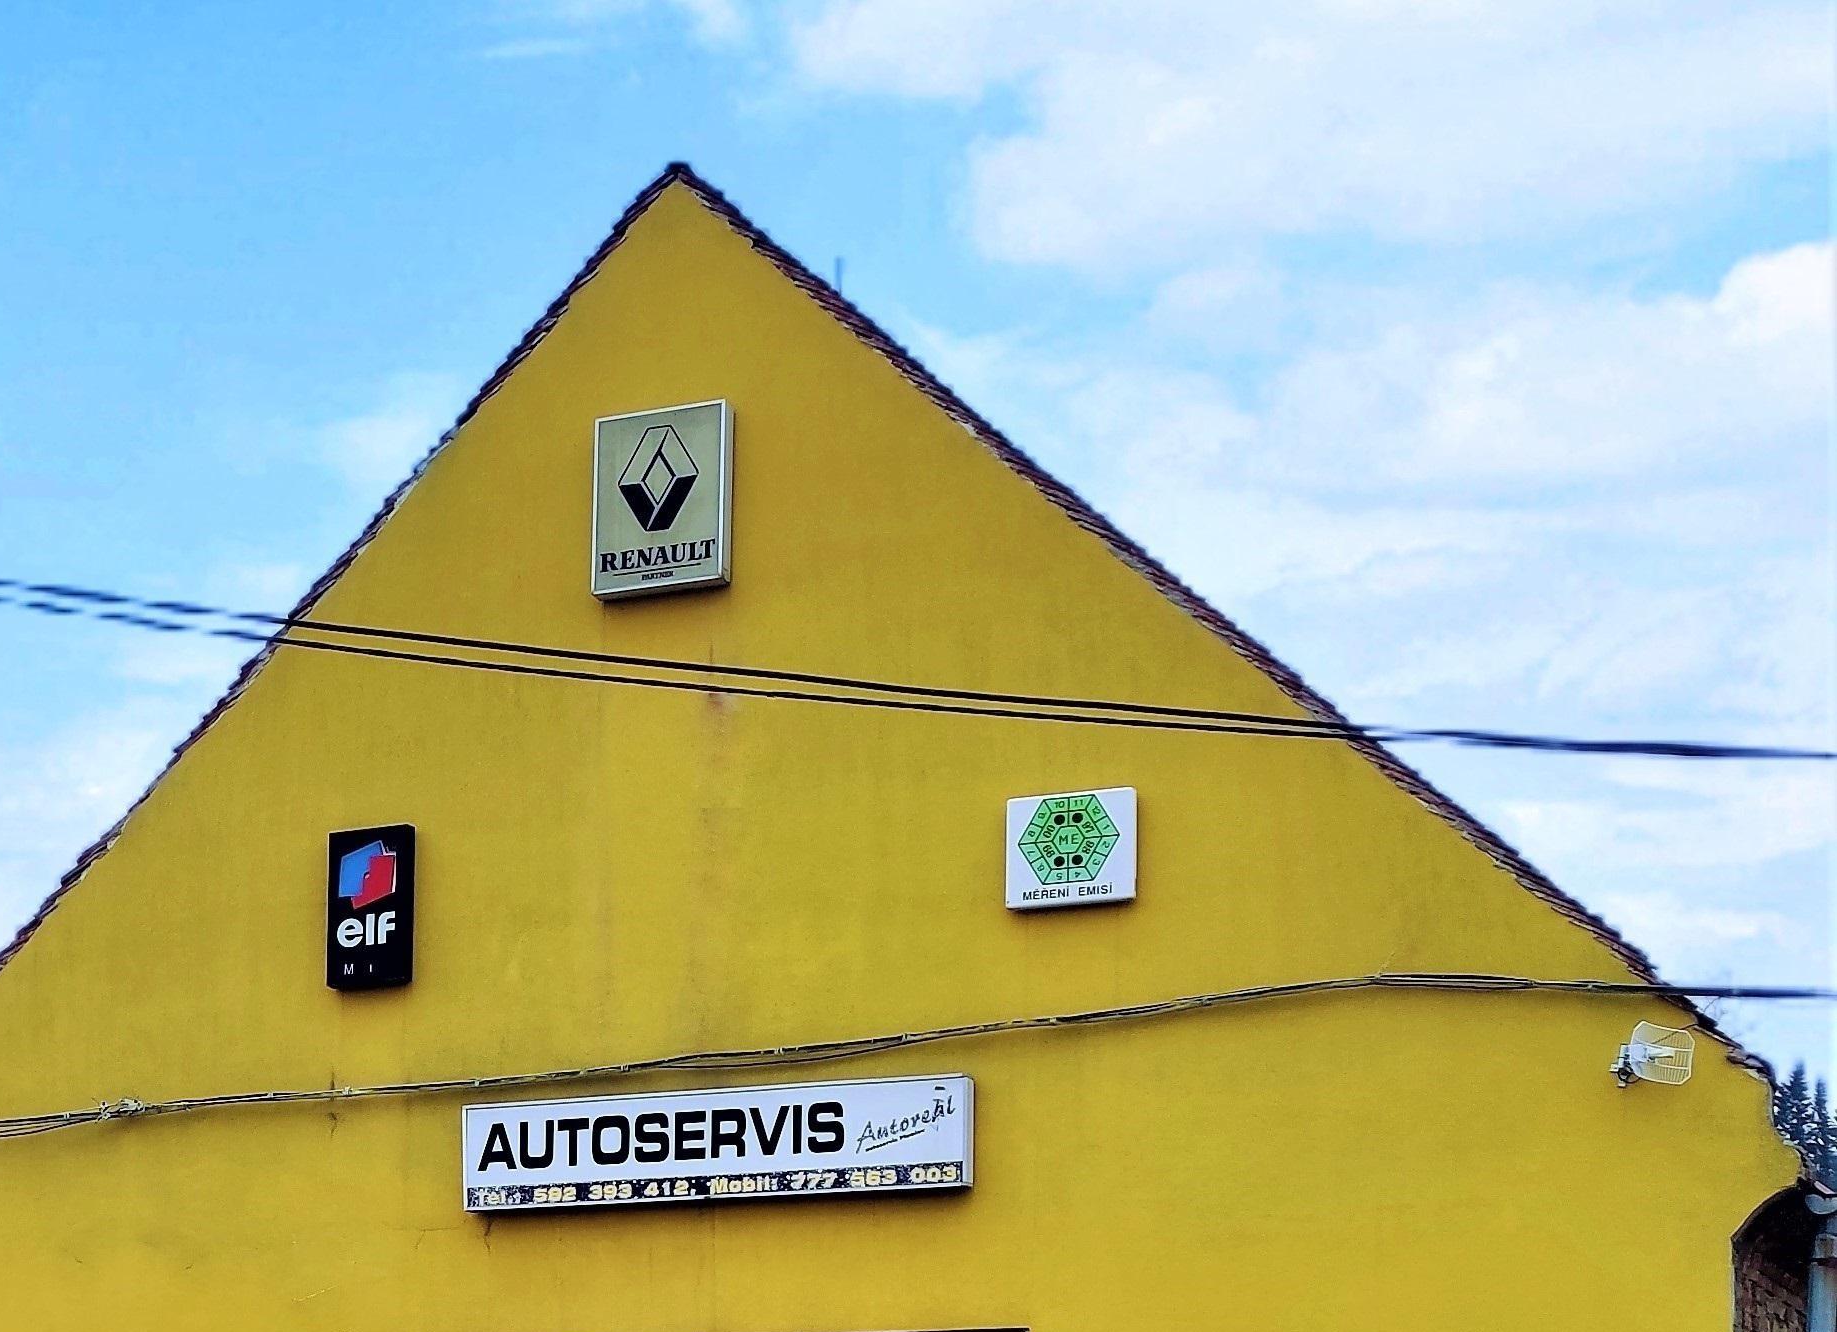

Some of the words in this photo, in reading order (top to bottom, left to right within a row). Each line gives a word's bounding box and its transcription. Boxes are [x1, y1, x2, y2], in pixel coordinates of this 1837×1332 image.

[600, 539, 715, 573] RENAULT
[1059, 834, 1079, 845] ME
[1079, 882, 1112, 896] EMISÍ
[337, 911, 395, 947] elf
[478, 1102, 845, 1172] AUTOSERVIS
[791, 1172, 836, 1190] 777
[911, 1166, 957, 1183] 003
